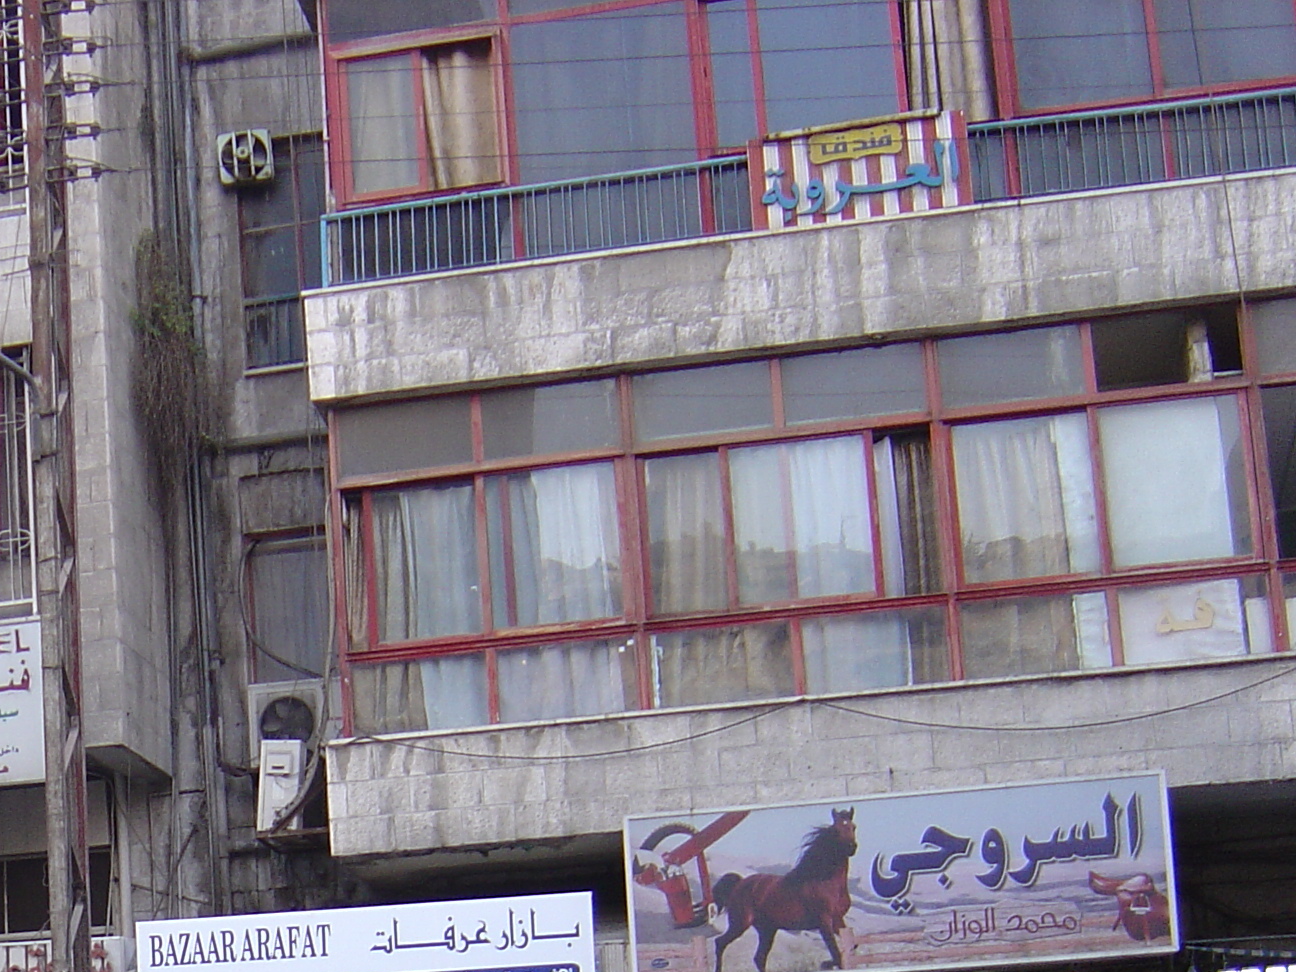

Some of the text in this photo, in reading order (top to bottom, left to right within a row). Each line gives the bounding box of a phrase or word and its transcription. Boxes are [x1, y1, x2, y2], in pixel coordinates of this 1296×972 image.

[821, 129, 893, 156] فندق
[762, 140, 959, 223] العروبة
[870, 790, 1141, 914] السروجي
[149, 923, 332, 968] BAZAAR ARAFAT
[370, 907, 581, 955] بازار عرفات
[930, 906, 1077, 942] محمد الوزان
